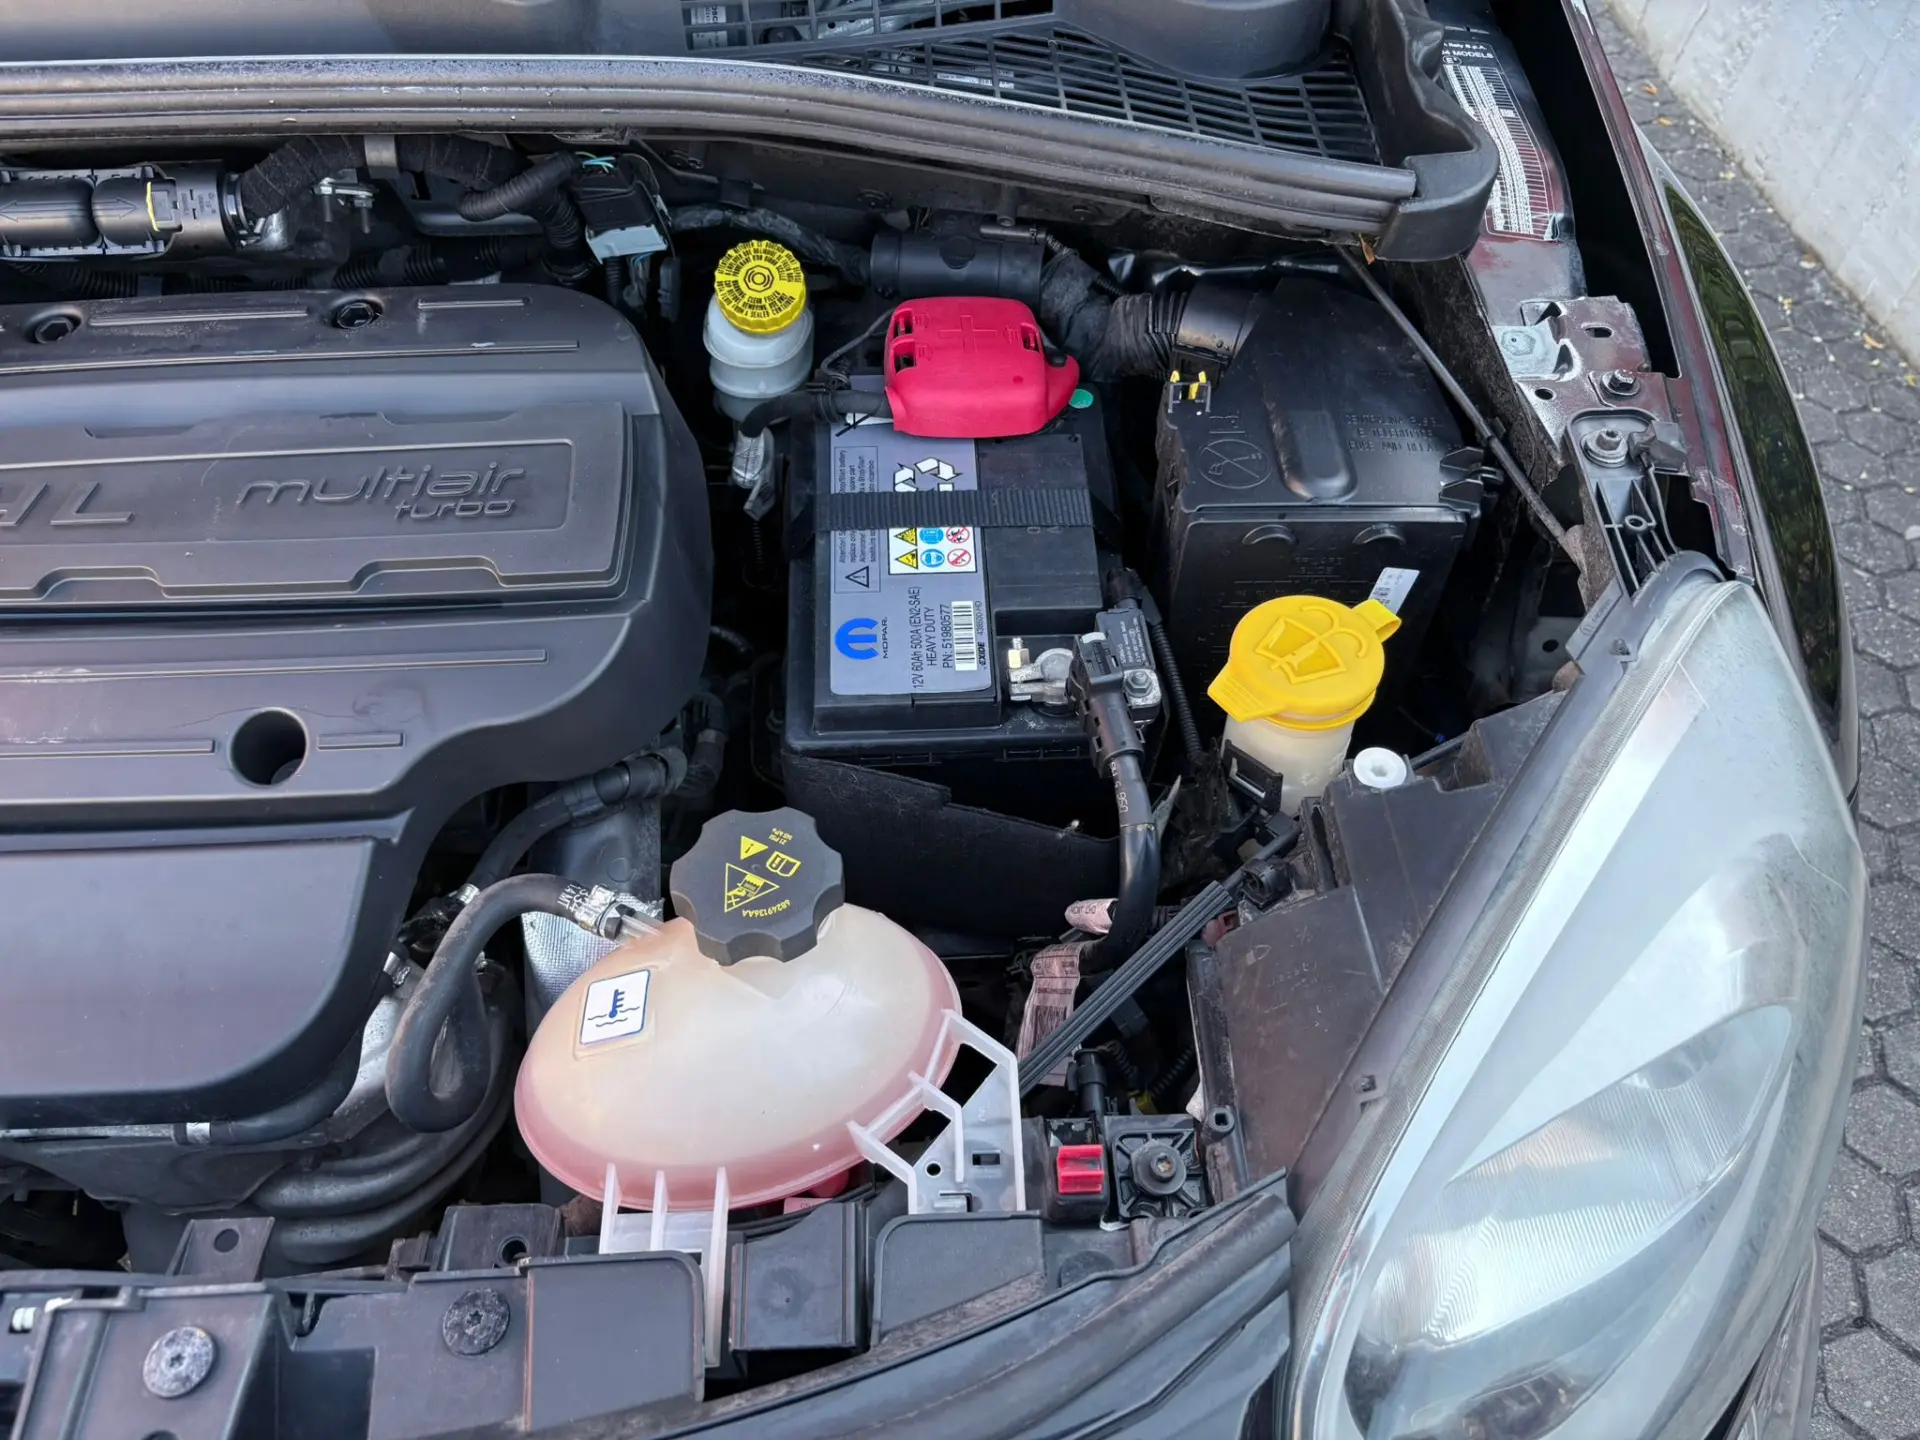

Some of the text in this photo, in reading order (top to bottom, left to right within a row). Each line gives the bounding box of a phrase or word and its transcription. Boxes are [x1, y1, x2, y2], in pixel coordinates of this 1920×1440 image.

[235, 460, 525, 505] multiair
[848, 465, 857, 475] part
[393, 498, 518, 521] turbo
[848, 543, 857, 563] replace
[907, 586, 925, 689] 12V 60Ah 500A (EN2-SAE)
[924, 607, 938, 667] HEAVY DUTY
[939, 603, 954, 669] PN: 51980577
[741, 898, 791, 918] 68249136AA
